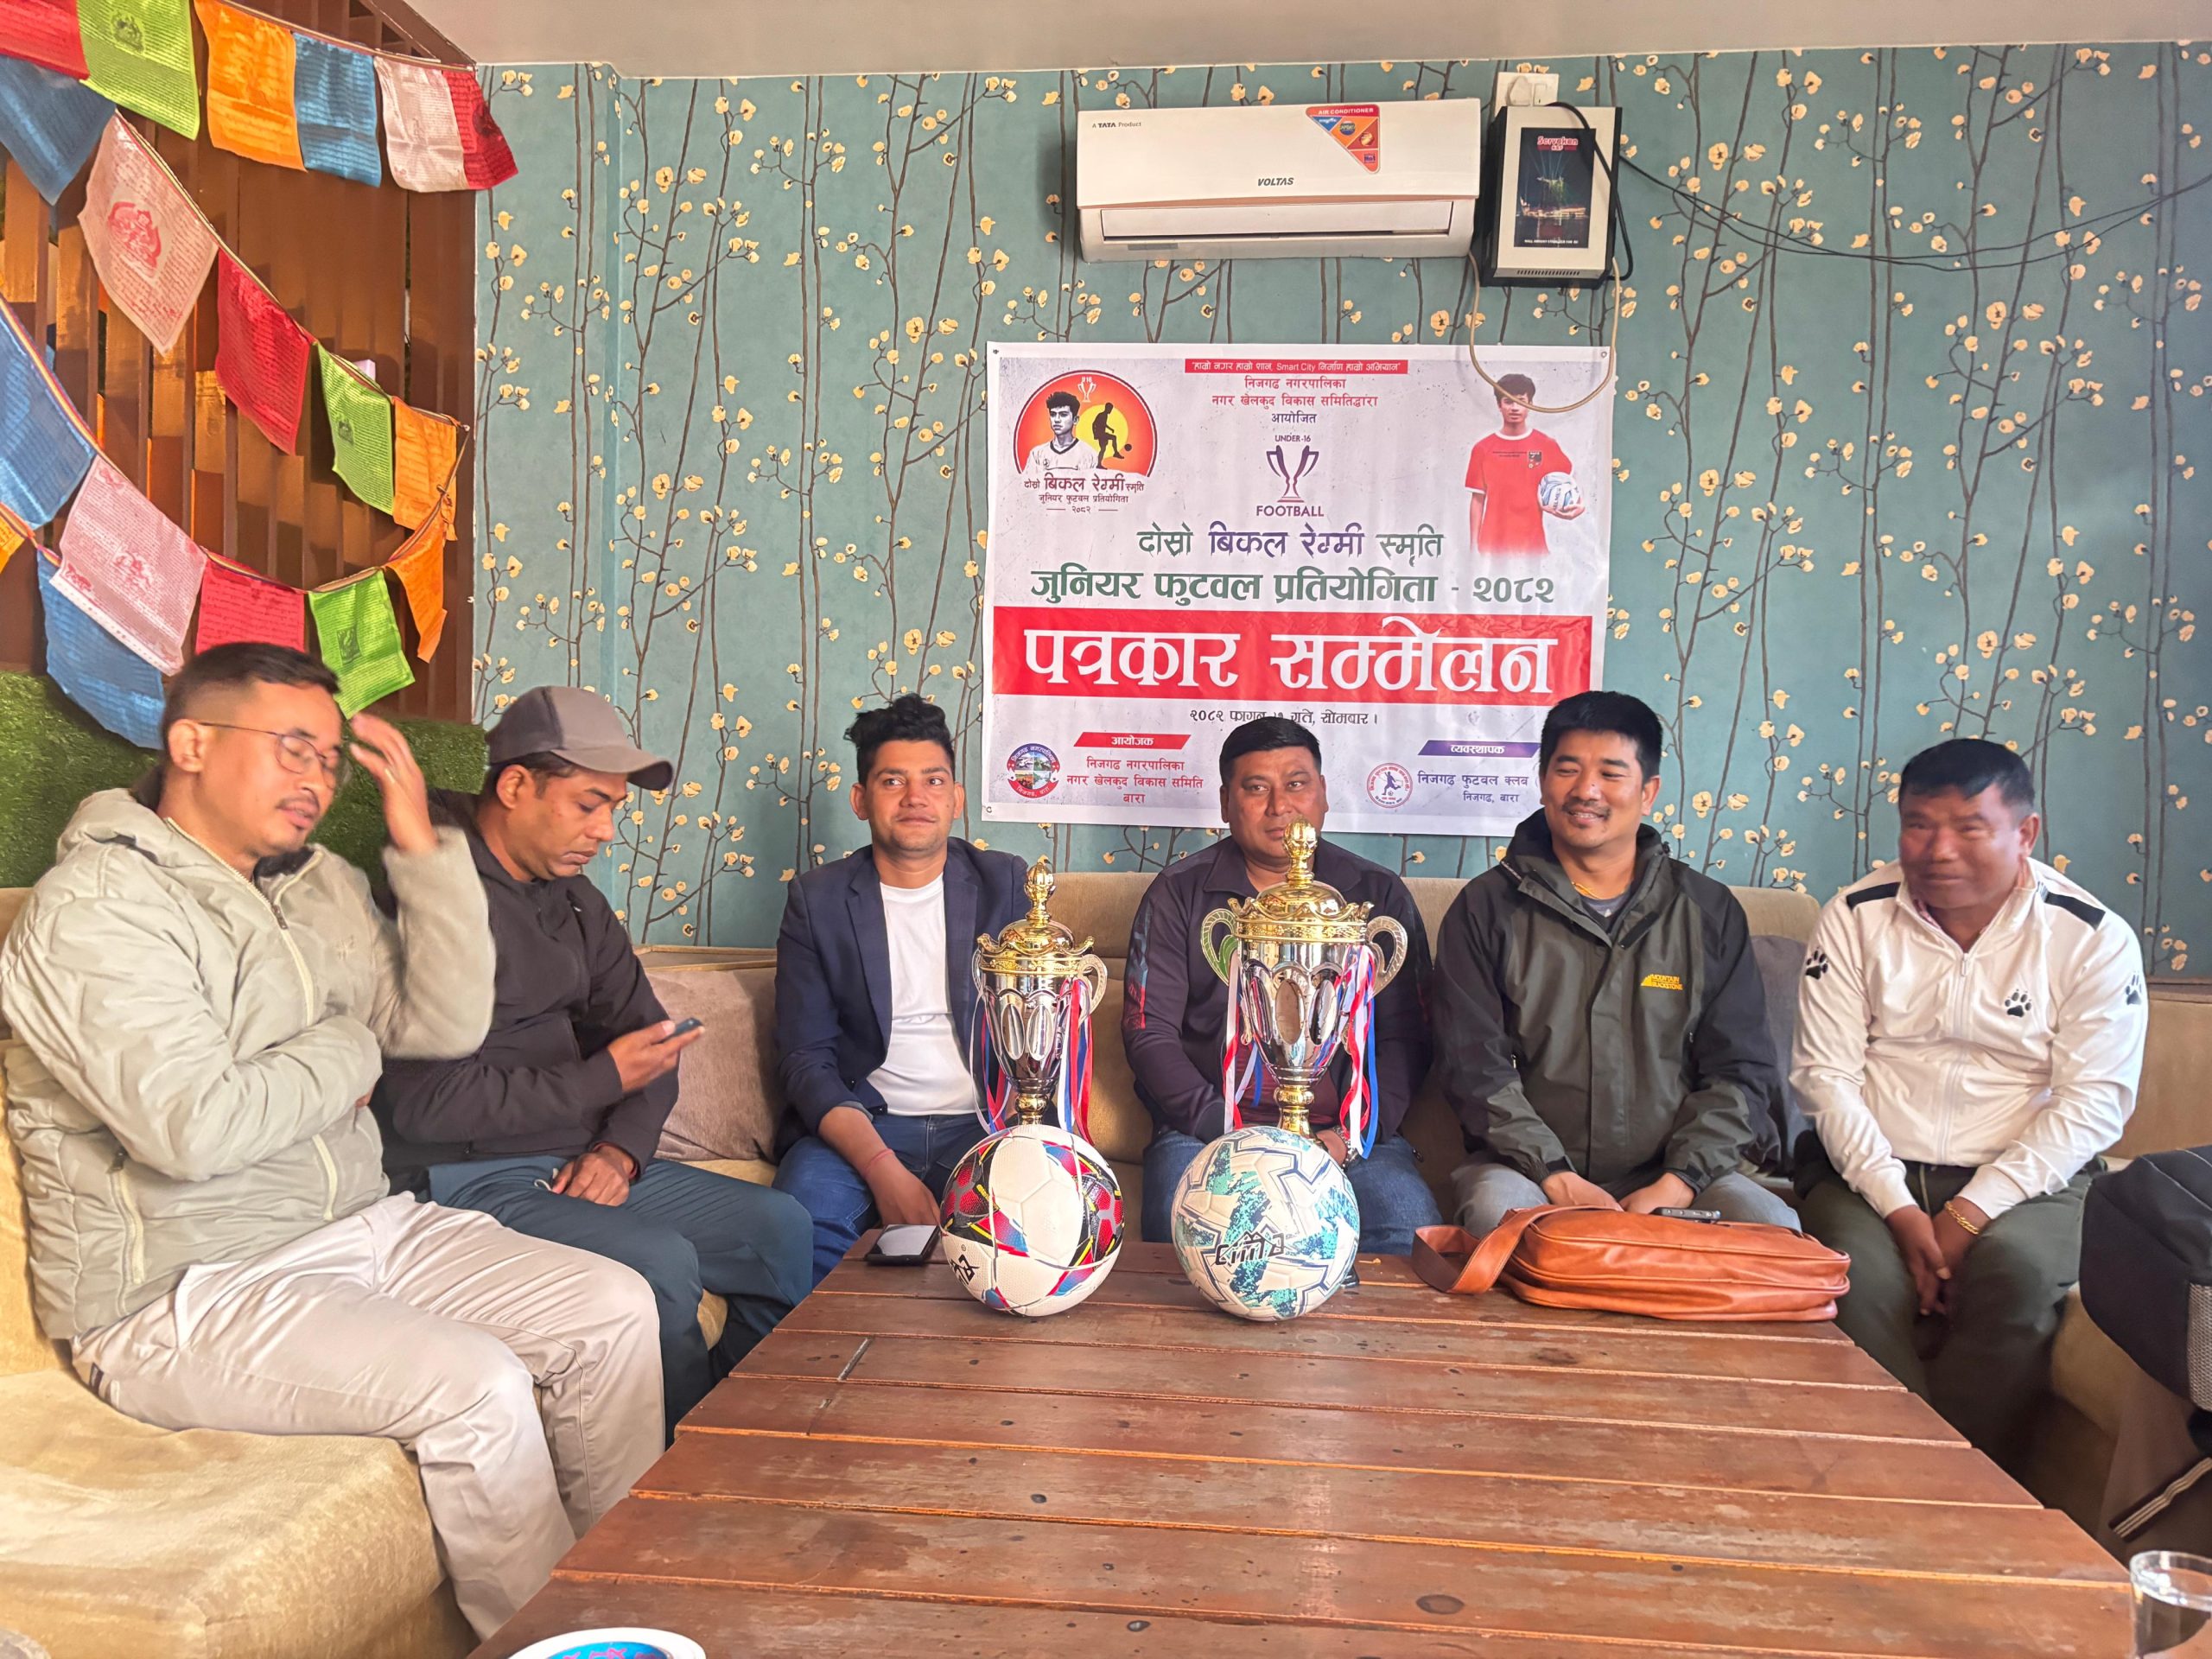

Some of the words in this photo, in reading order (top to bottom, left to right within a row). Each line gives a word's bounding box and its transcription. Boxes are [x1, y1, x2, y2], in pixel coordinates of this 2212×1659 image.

[1257, 177, 1294, 187] VOLTAS
[1301, 363, 1315, 372] City
[1244, 376, 1281, 390] निजगढ
[1286, 376, 1346, 390] नगरपालिका
[1211, 395, 1236, 407] नगर
[1240, 394, 1275, 410] खेलकुद
[1281, 393, 1315, 407] विकास
[1271, 410, 1317, 424] आयोजित
[1044, 472, 1086, 493] बिकल
[1039, 493, 1062, 505] जुनियर
[1092, 493, 1128, 503] प्रतियोगिता
[1256, 505, 1325, 517] FOOTBALL
[1136, 521, 1194, 557] दोस्रो
[1208, 520, 1288, 558] बिकल
[1300, 521, 1365, 558] रेग्मी
[1376, 524, 1445, 567] स्मृति
[1031, 562, 1145, 604] जुनियर
[1273, 565, 1439, 604] प्रतियोगिता
[1472, 576, 1554, 603] २०८२
[1023, 629, 1241, 689] पत्रकार
[1270, 615, 1559, 693] सम्मेलन
[1190, 709, 1224, 722] २०८२
[1111, 734, 1154, 747] आयोजक
[1451, 743, 1505, 754] व्यवस्थापक
[1086, 756, 1122, 770] निजगढ
[1127, 757, 1185, 771] नगरपालिका
[1066, 774, 1090, 785] नगर
[1094, 774, 1128, 790] खेलकुद
[1134, 774, 1166, 788] विकास
[1172, 775, 1204, 789] समिति
[1417, 770, 1456, 785] निजगढ
